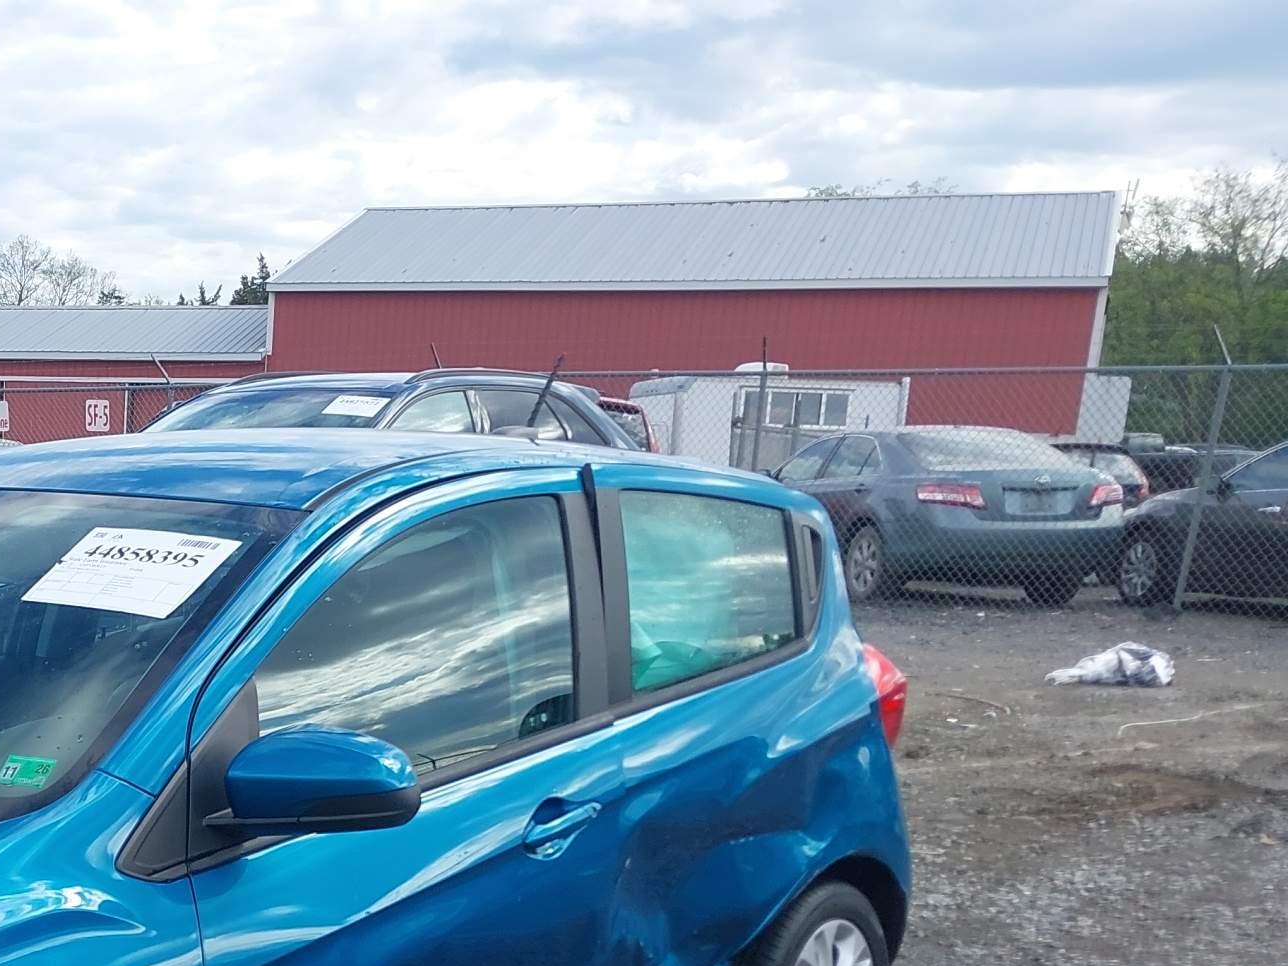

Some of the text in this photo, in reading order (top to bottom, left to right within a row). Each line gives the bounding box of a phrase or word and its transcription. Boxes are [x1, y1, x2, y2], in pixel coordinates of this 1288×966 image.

[87, 404, 109, 427] SF-5
[84, 544, 206, 568] 44858395
[2, 765, 18, 778] 11
